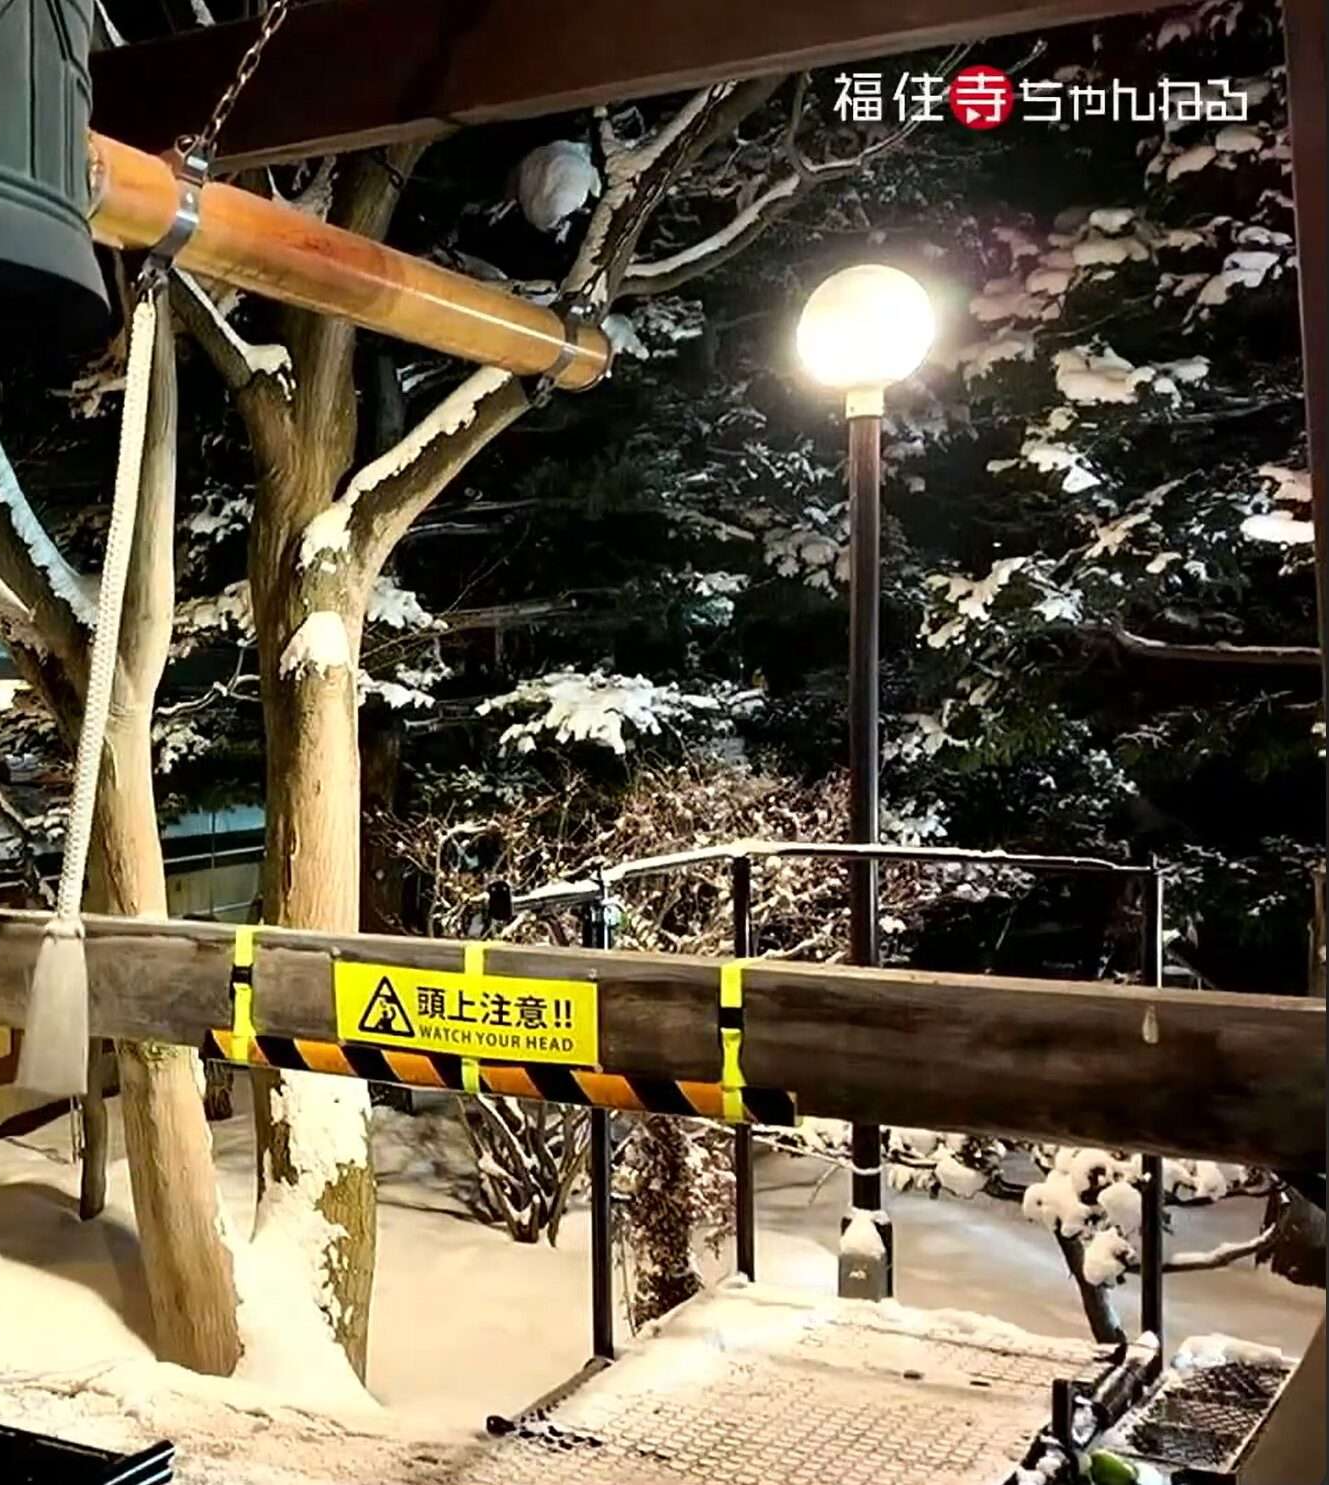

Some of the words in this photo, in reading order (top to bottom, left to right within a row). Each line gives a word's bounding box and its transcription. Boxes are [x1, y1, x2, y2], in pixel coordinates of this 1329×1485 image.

[416, 986, 573, 1029] 頭上注意!!
[418, 1024, 472, 1044] WATCH
[476, 1031, 521, 1049] YOUR
[525, 1035, 574, 1052] HEAD
